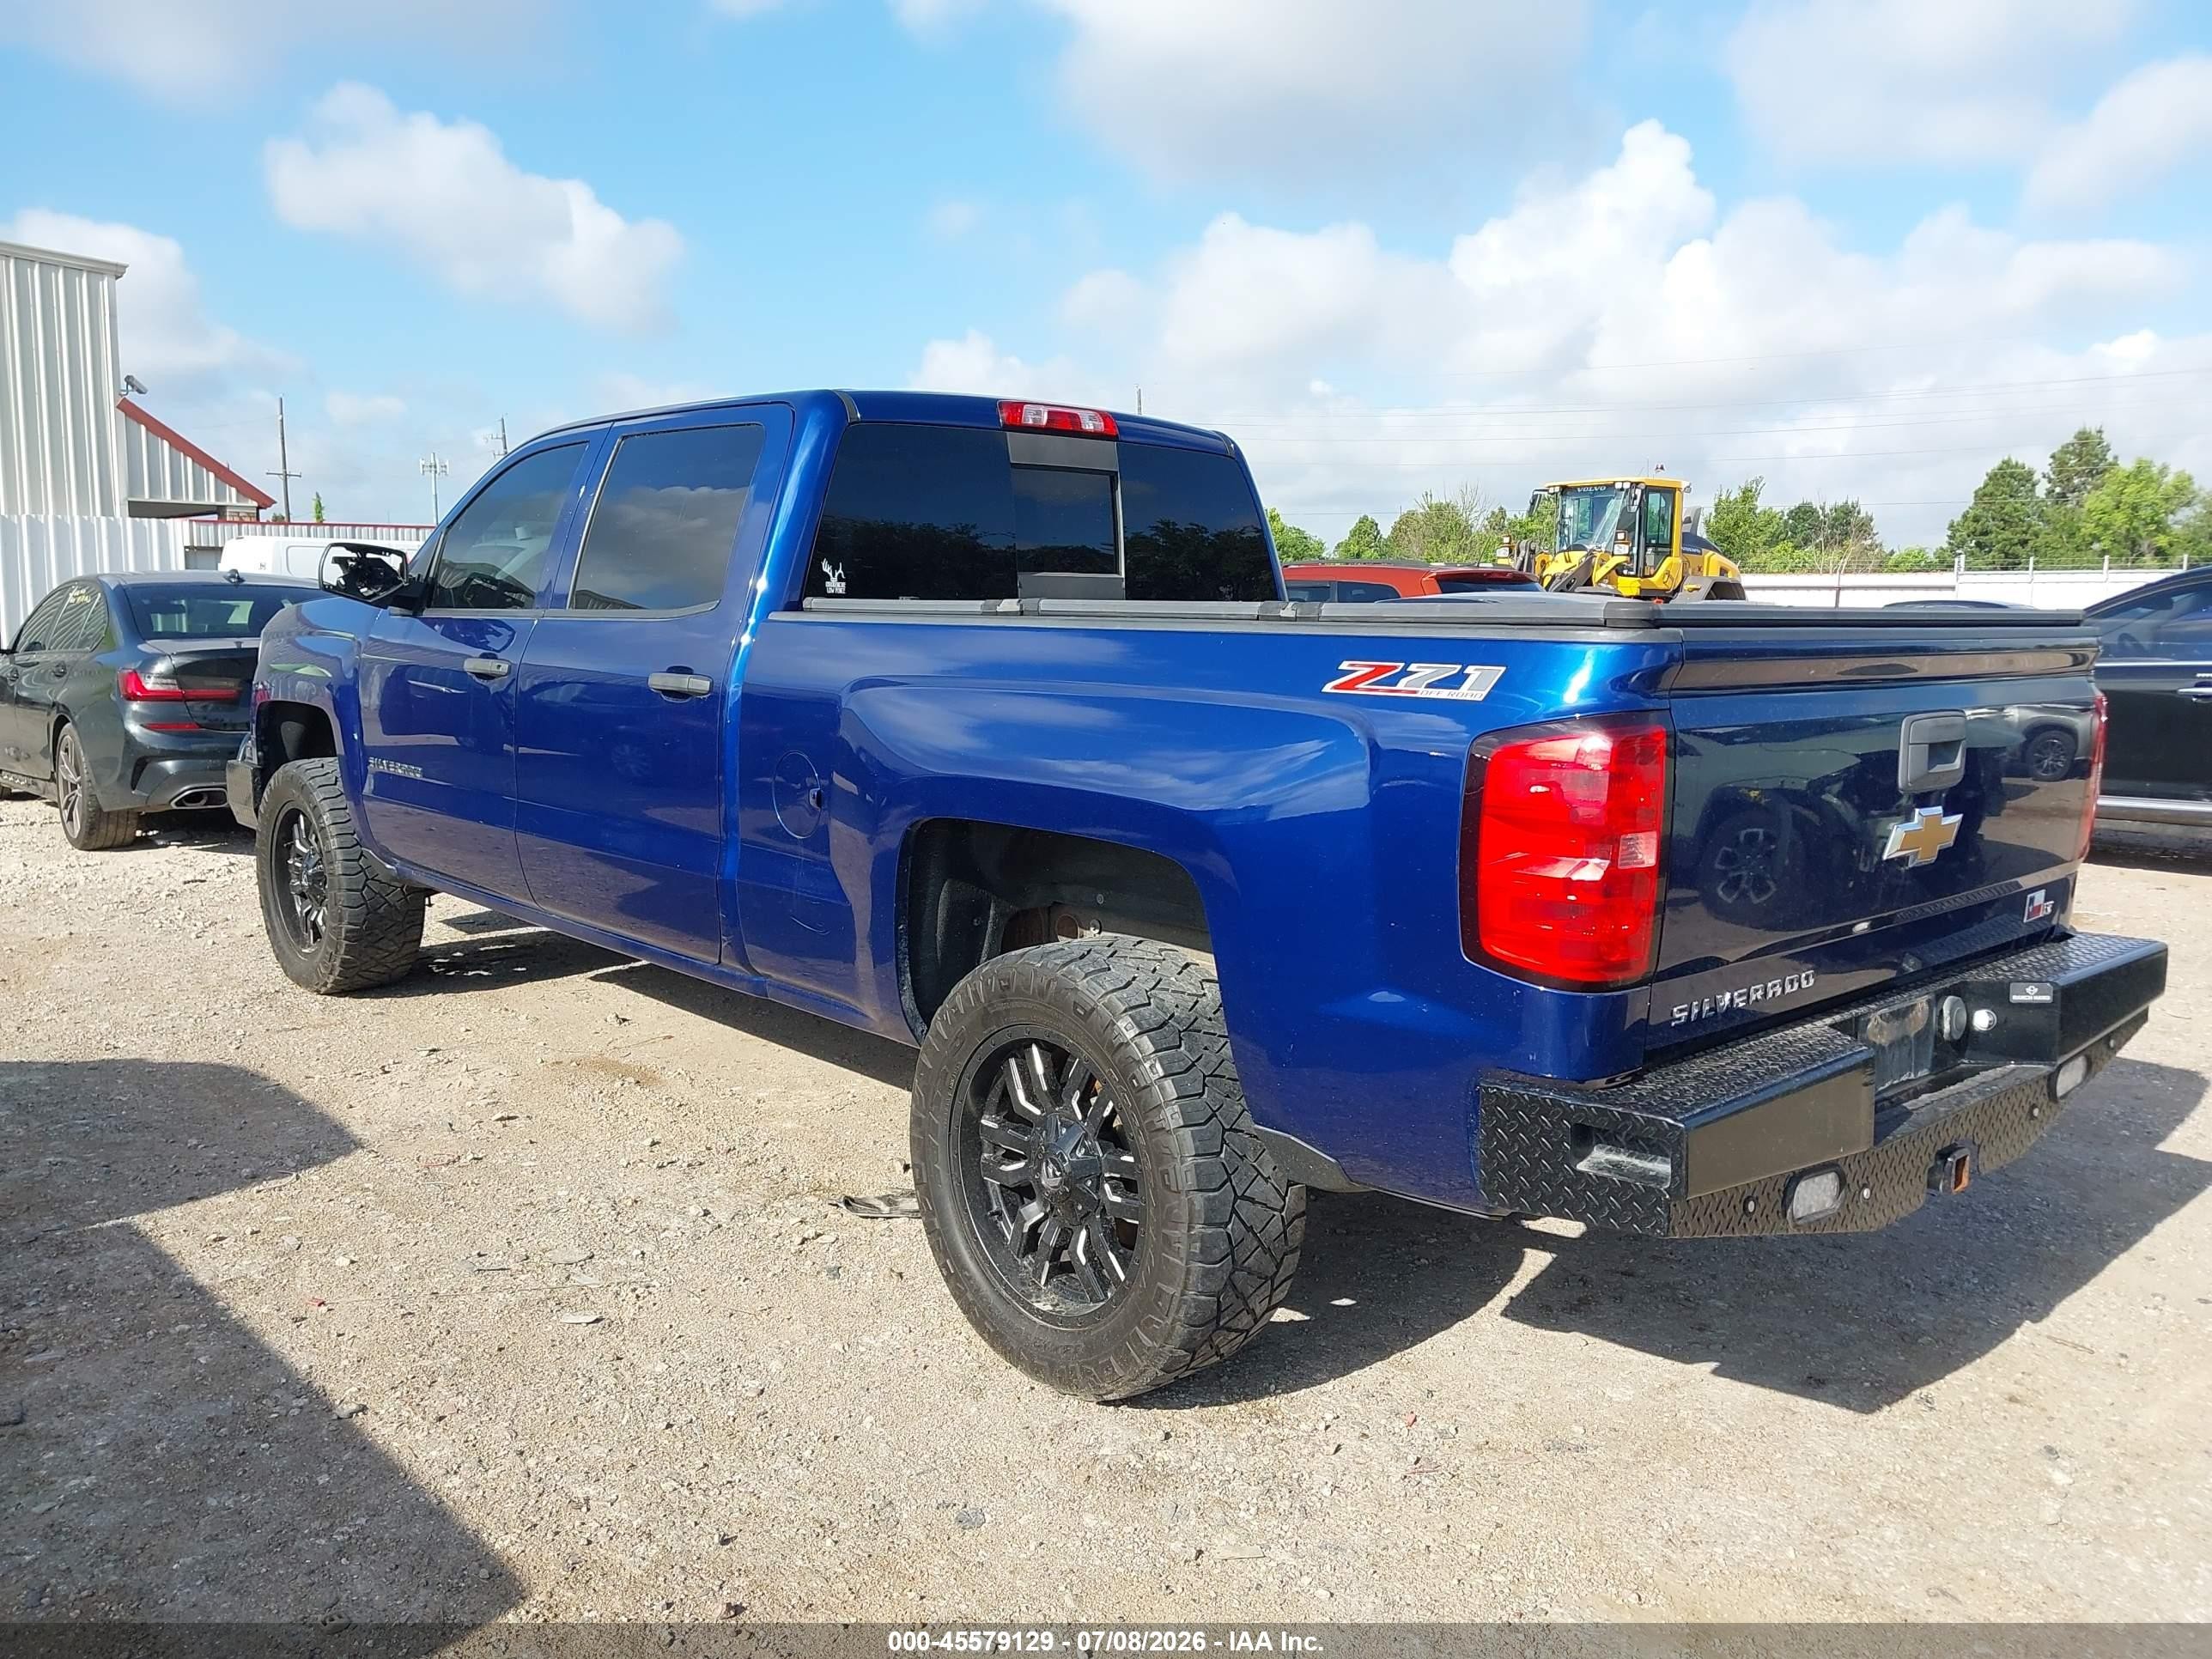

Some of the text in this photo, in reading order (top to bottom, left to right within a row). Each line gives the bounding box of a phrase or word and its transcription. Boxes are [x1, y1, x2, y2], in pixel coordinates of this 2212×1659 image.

[1322, 660, 1507, 702] Z71
[1447, 691, 1484, 700] ROAD
[1671, 969, 1814, 1026] SILVERADO
